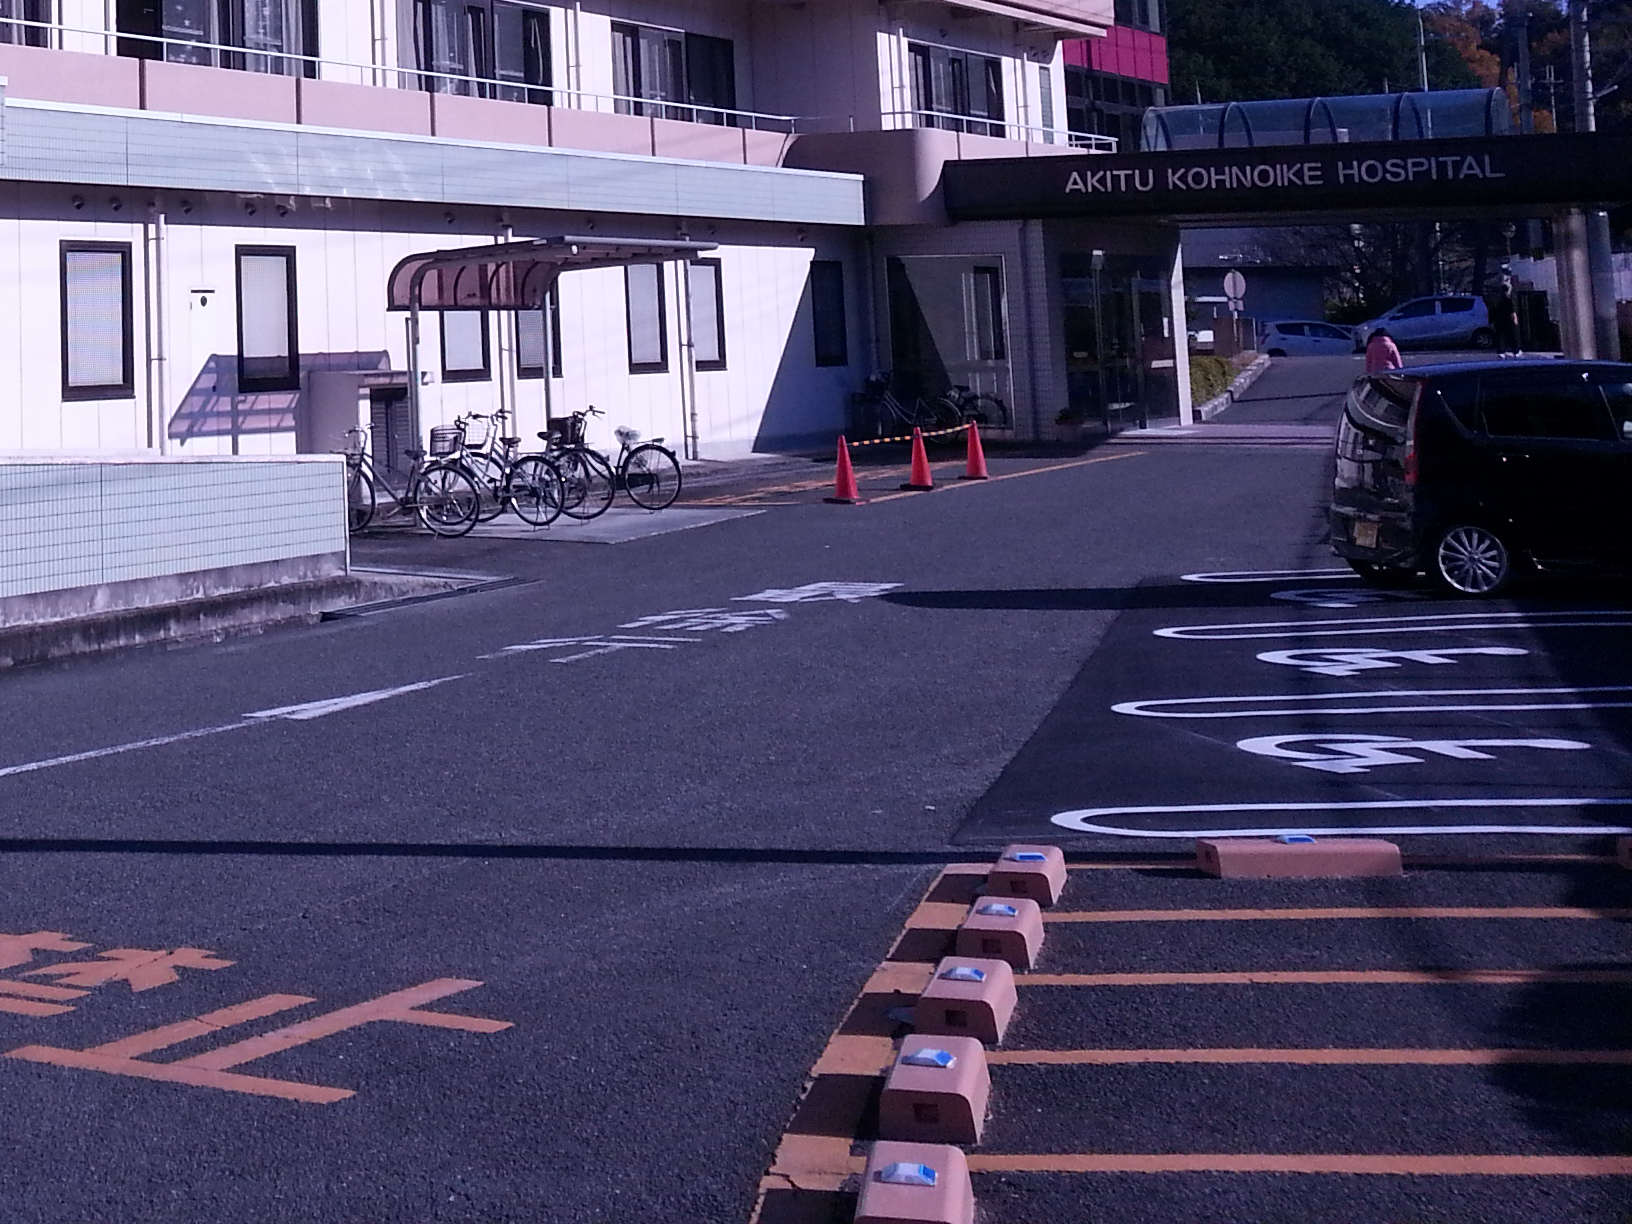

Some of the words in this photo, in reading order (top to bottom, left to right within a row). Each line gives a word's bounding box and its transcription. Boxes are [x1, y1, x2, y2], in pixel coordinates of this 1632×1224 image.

[1064, 167, 1155, 195] AKITU
[1166, 160, 1325, 191] KOHNOIKE
[1337, 153, 1506, 185] HOSPITAL
